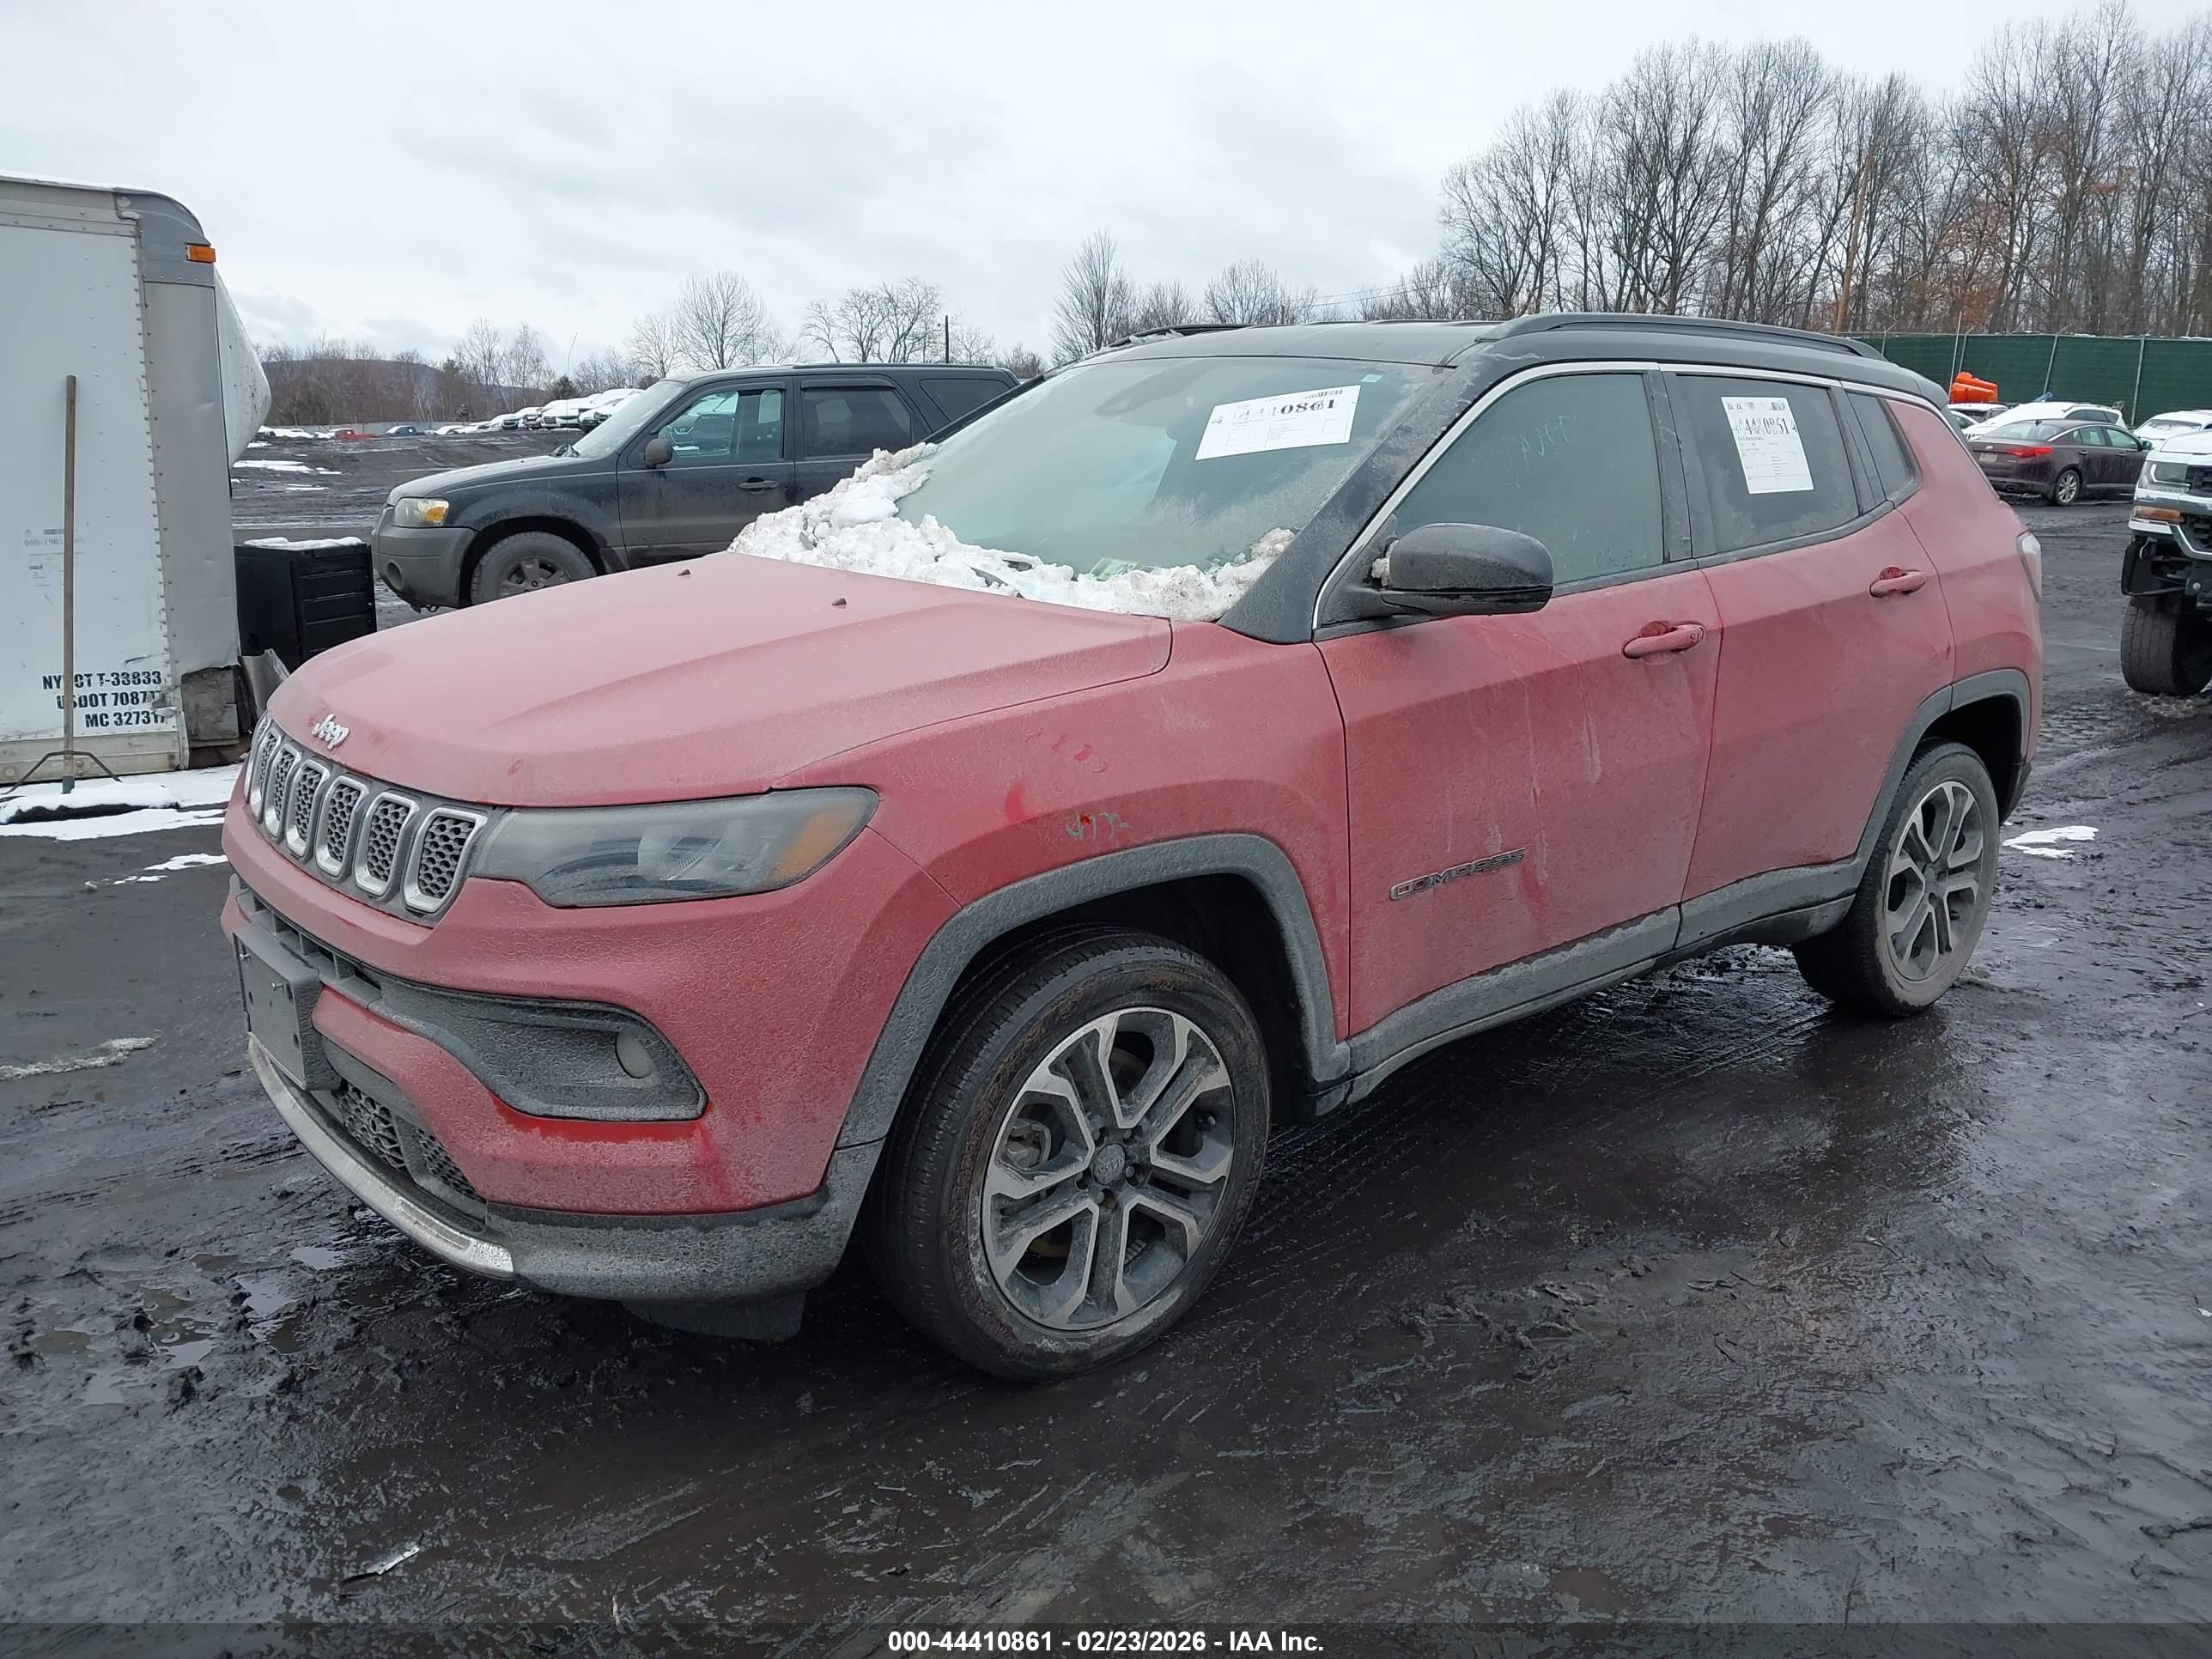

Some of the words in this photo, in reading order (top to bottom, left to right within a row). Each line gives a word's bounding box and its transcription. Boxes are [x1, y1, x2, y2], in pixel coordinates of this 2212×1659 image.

[42, 674, 93, 690] NYOT
[96, 671, 162, 687] T-33833
[84, 713, 110, 727] MC
[312, 714, 349, 750] Jeep
[1389, 847, 1526, 901] COMPASS
